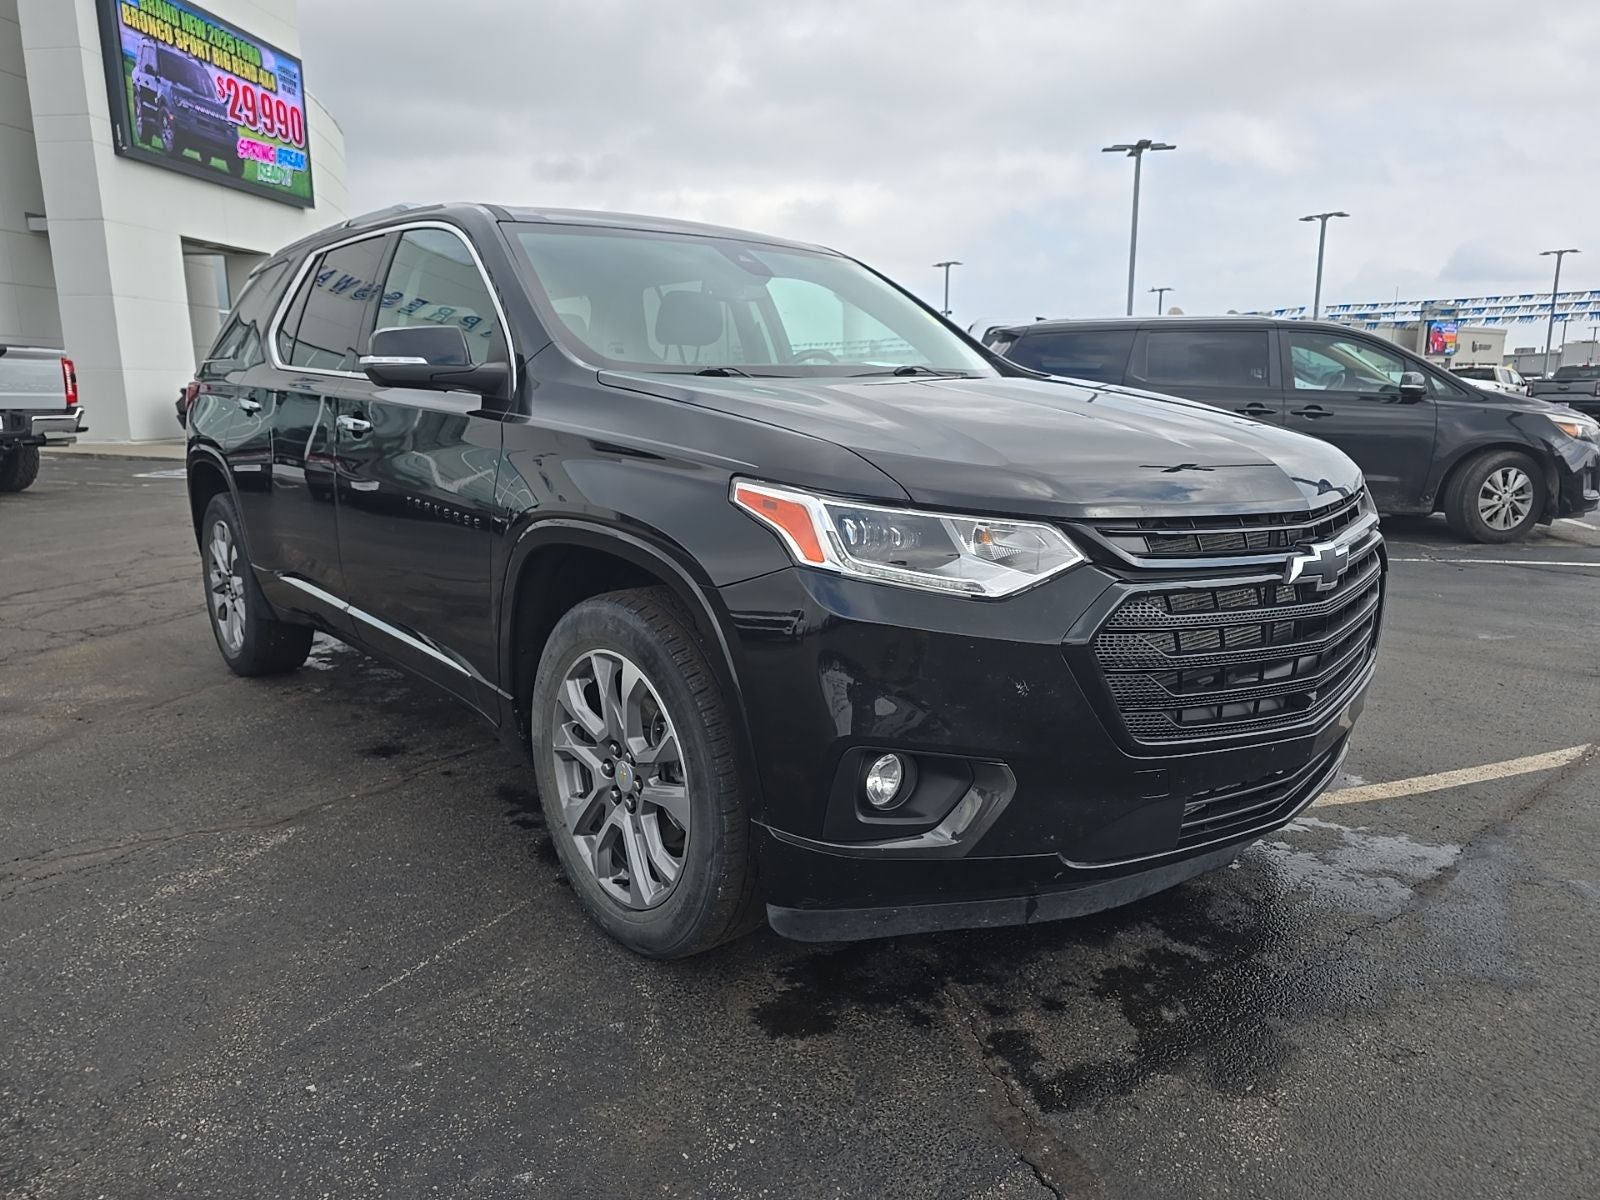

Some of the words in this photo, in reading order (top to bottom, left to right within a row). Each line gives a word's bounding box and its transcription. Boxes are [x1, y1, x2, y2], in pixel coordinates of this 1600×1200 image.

[174, 28, 211, 62] SPORT
[211, 45, 231, 73] BIG
[207, 24, 236, 54] 2025
